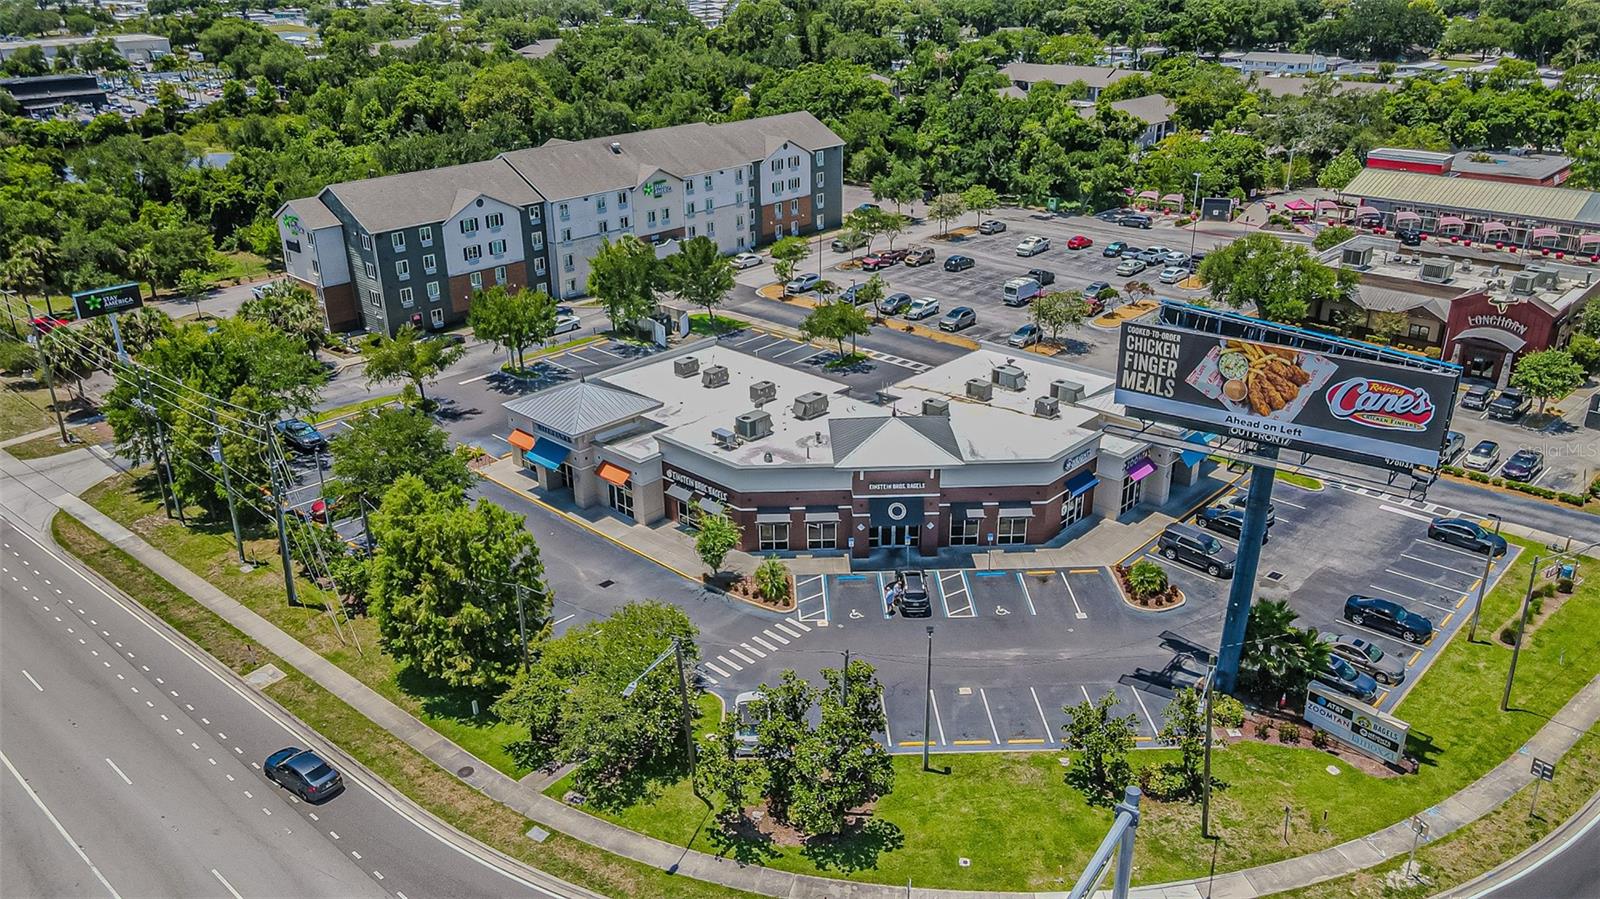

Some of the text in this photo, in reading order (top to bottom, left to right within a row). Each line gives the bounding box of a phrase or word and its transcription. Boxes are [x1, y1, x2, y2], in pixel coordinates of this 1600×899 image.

[1127, 325, 1181, 343] COOKED-TO-ORDER
[1468, 315, 1528, 336] LONGHORN
[1126, 335, 1180, 359] CHICKEN
[1124, 350, 1178, 378] FINGER
[1121, 369, 1175, 398] MEALS
[1369, 382, 1405, 396] Raising
[1330, 377, 1432, 417] Cane's
[1225, 415, 1302, 437] Ahead on Left
[1307, 703, 1351, 729] ZOOMTAN
[1326, 702, 1345, 714] AT&T
[1372, 723, 1398, 741] BAGELS
